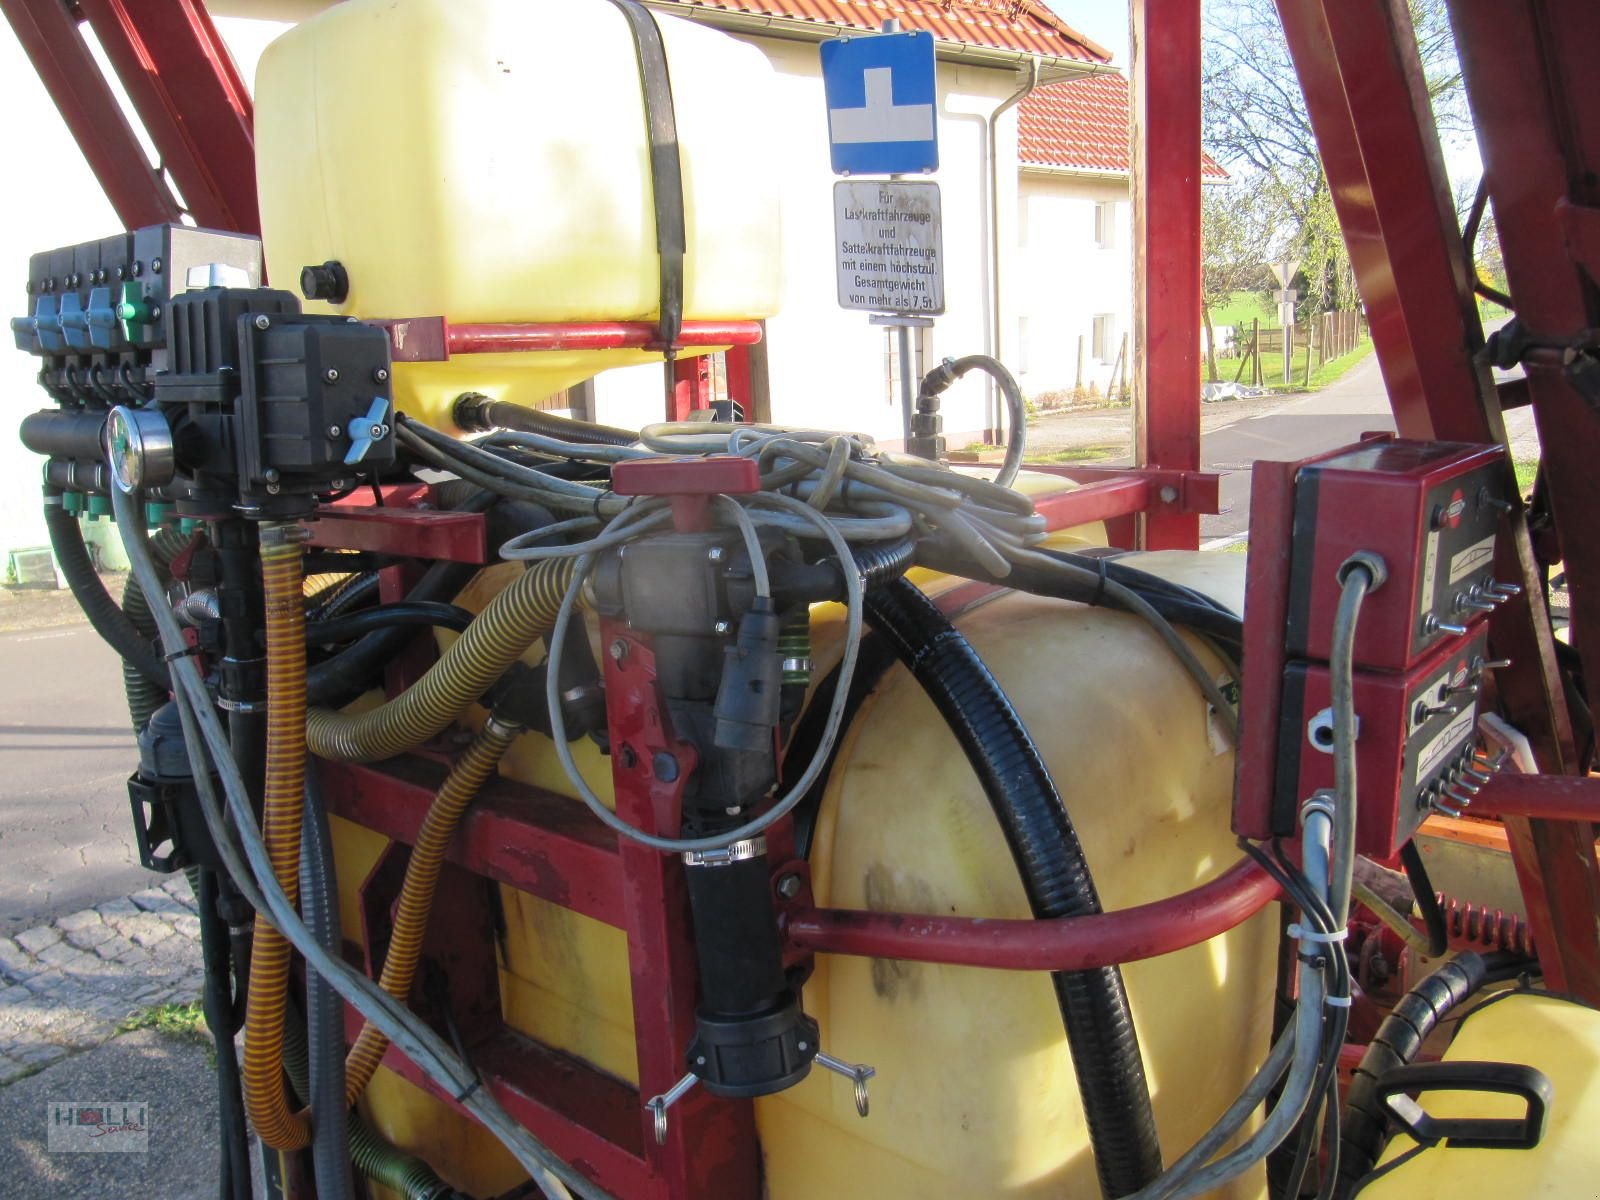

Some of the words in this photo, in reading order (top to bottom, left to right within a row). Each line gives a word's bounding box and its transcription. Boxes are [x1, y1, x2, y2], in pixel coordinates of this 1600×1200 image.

[879, 190, 894, 203] Für
[844, 207, 931, 224] Lastkraftfahrzeuge
[878, 226, 896, 238] und
[842, 241, 936, 260] Sattelkraftfahrzeuge
[842, 258, 856, 270] mit
[859, 259, 887, 272] einem
[890, 260, 938, 275] höchstzul.
[854, 275, 926, 292] Gesamtgewicht
[849, 293, 865, 304] von
[868, 293, 892, 306] mehr
[895, 294, 909, 307] als
